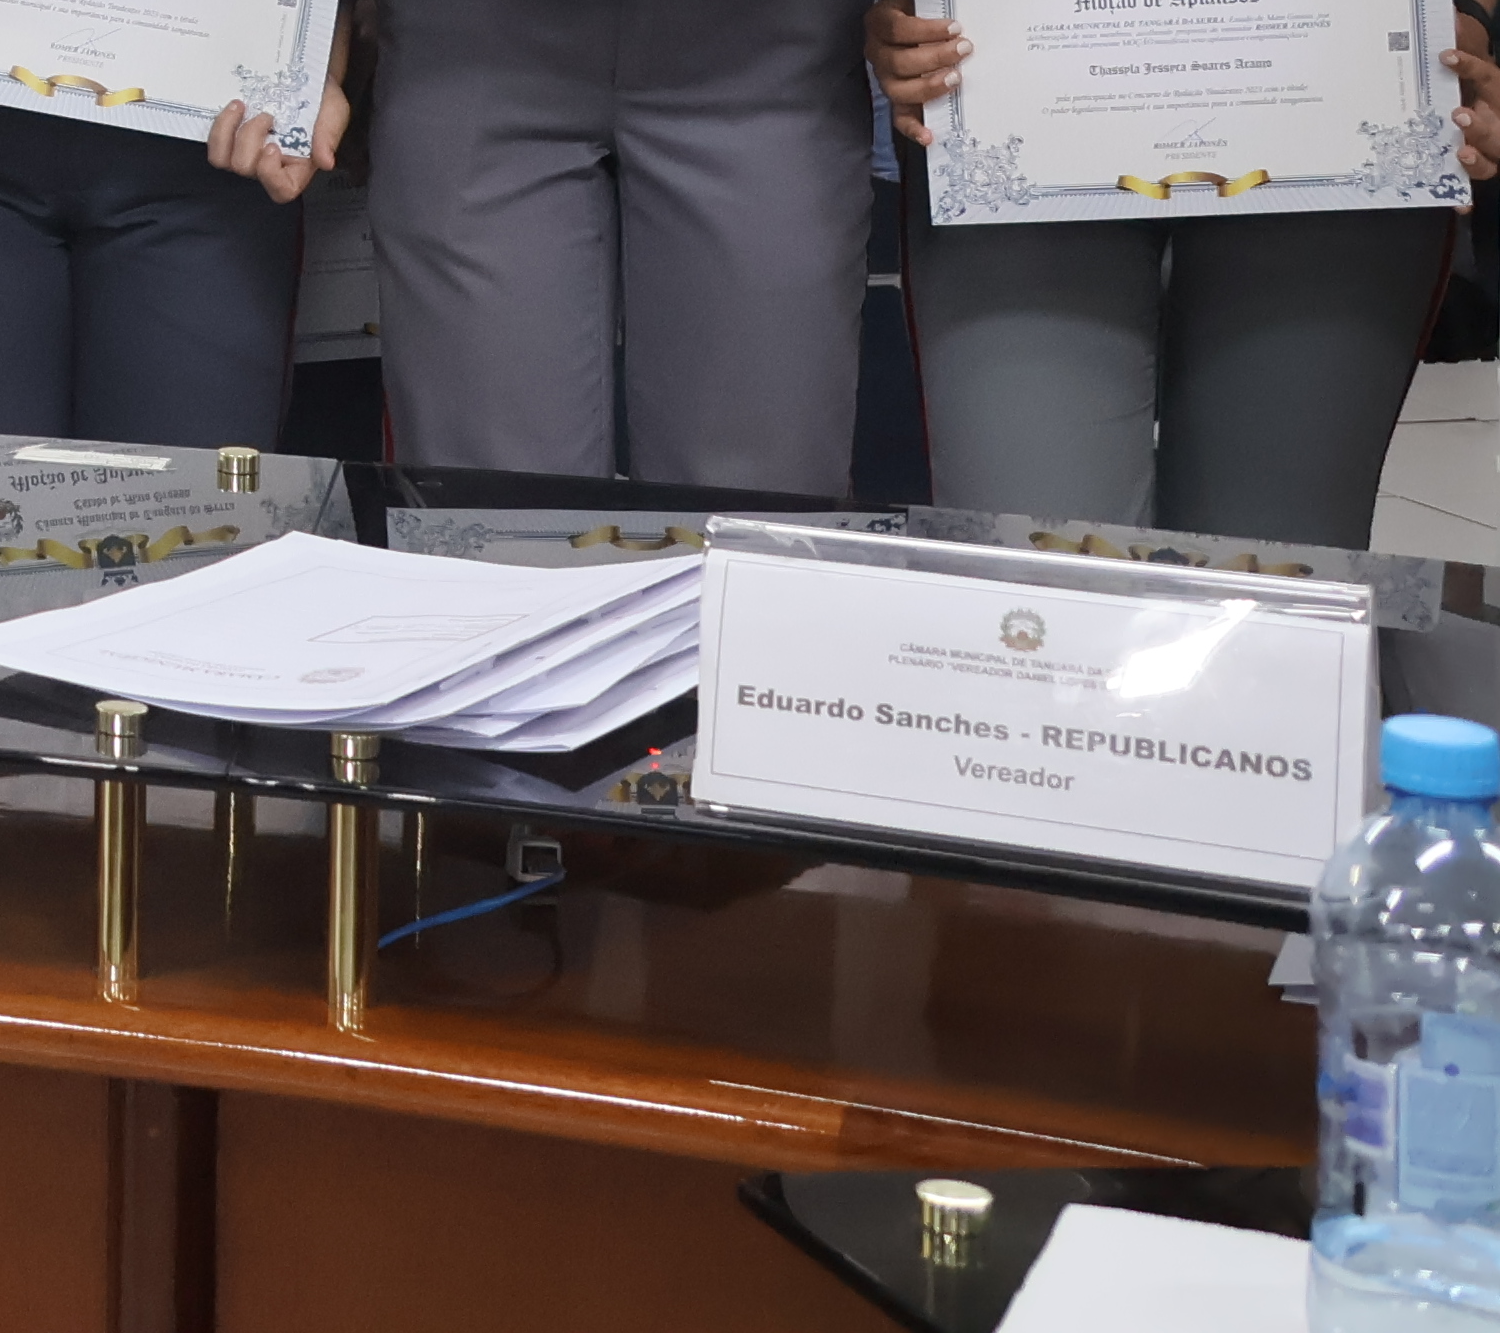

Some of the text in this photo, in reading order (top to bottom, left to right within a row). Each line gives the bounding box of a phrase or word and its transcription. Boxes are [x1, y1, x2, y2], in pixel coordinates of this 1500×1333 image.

[736, 684, 865, 723] Eduardo
[874, 703, 1010, 743] Sanches
[1041, 723, 1313, 783] REPUBLICANOS
[952, 754, 1076, 793] Vereador
